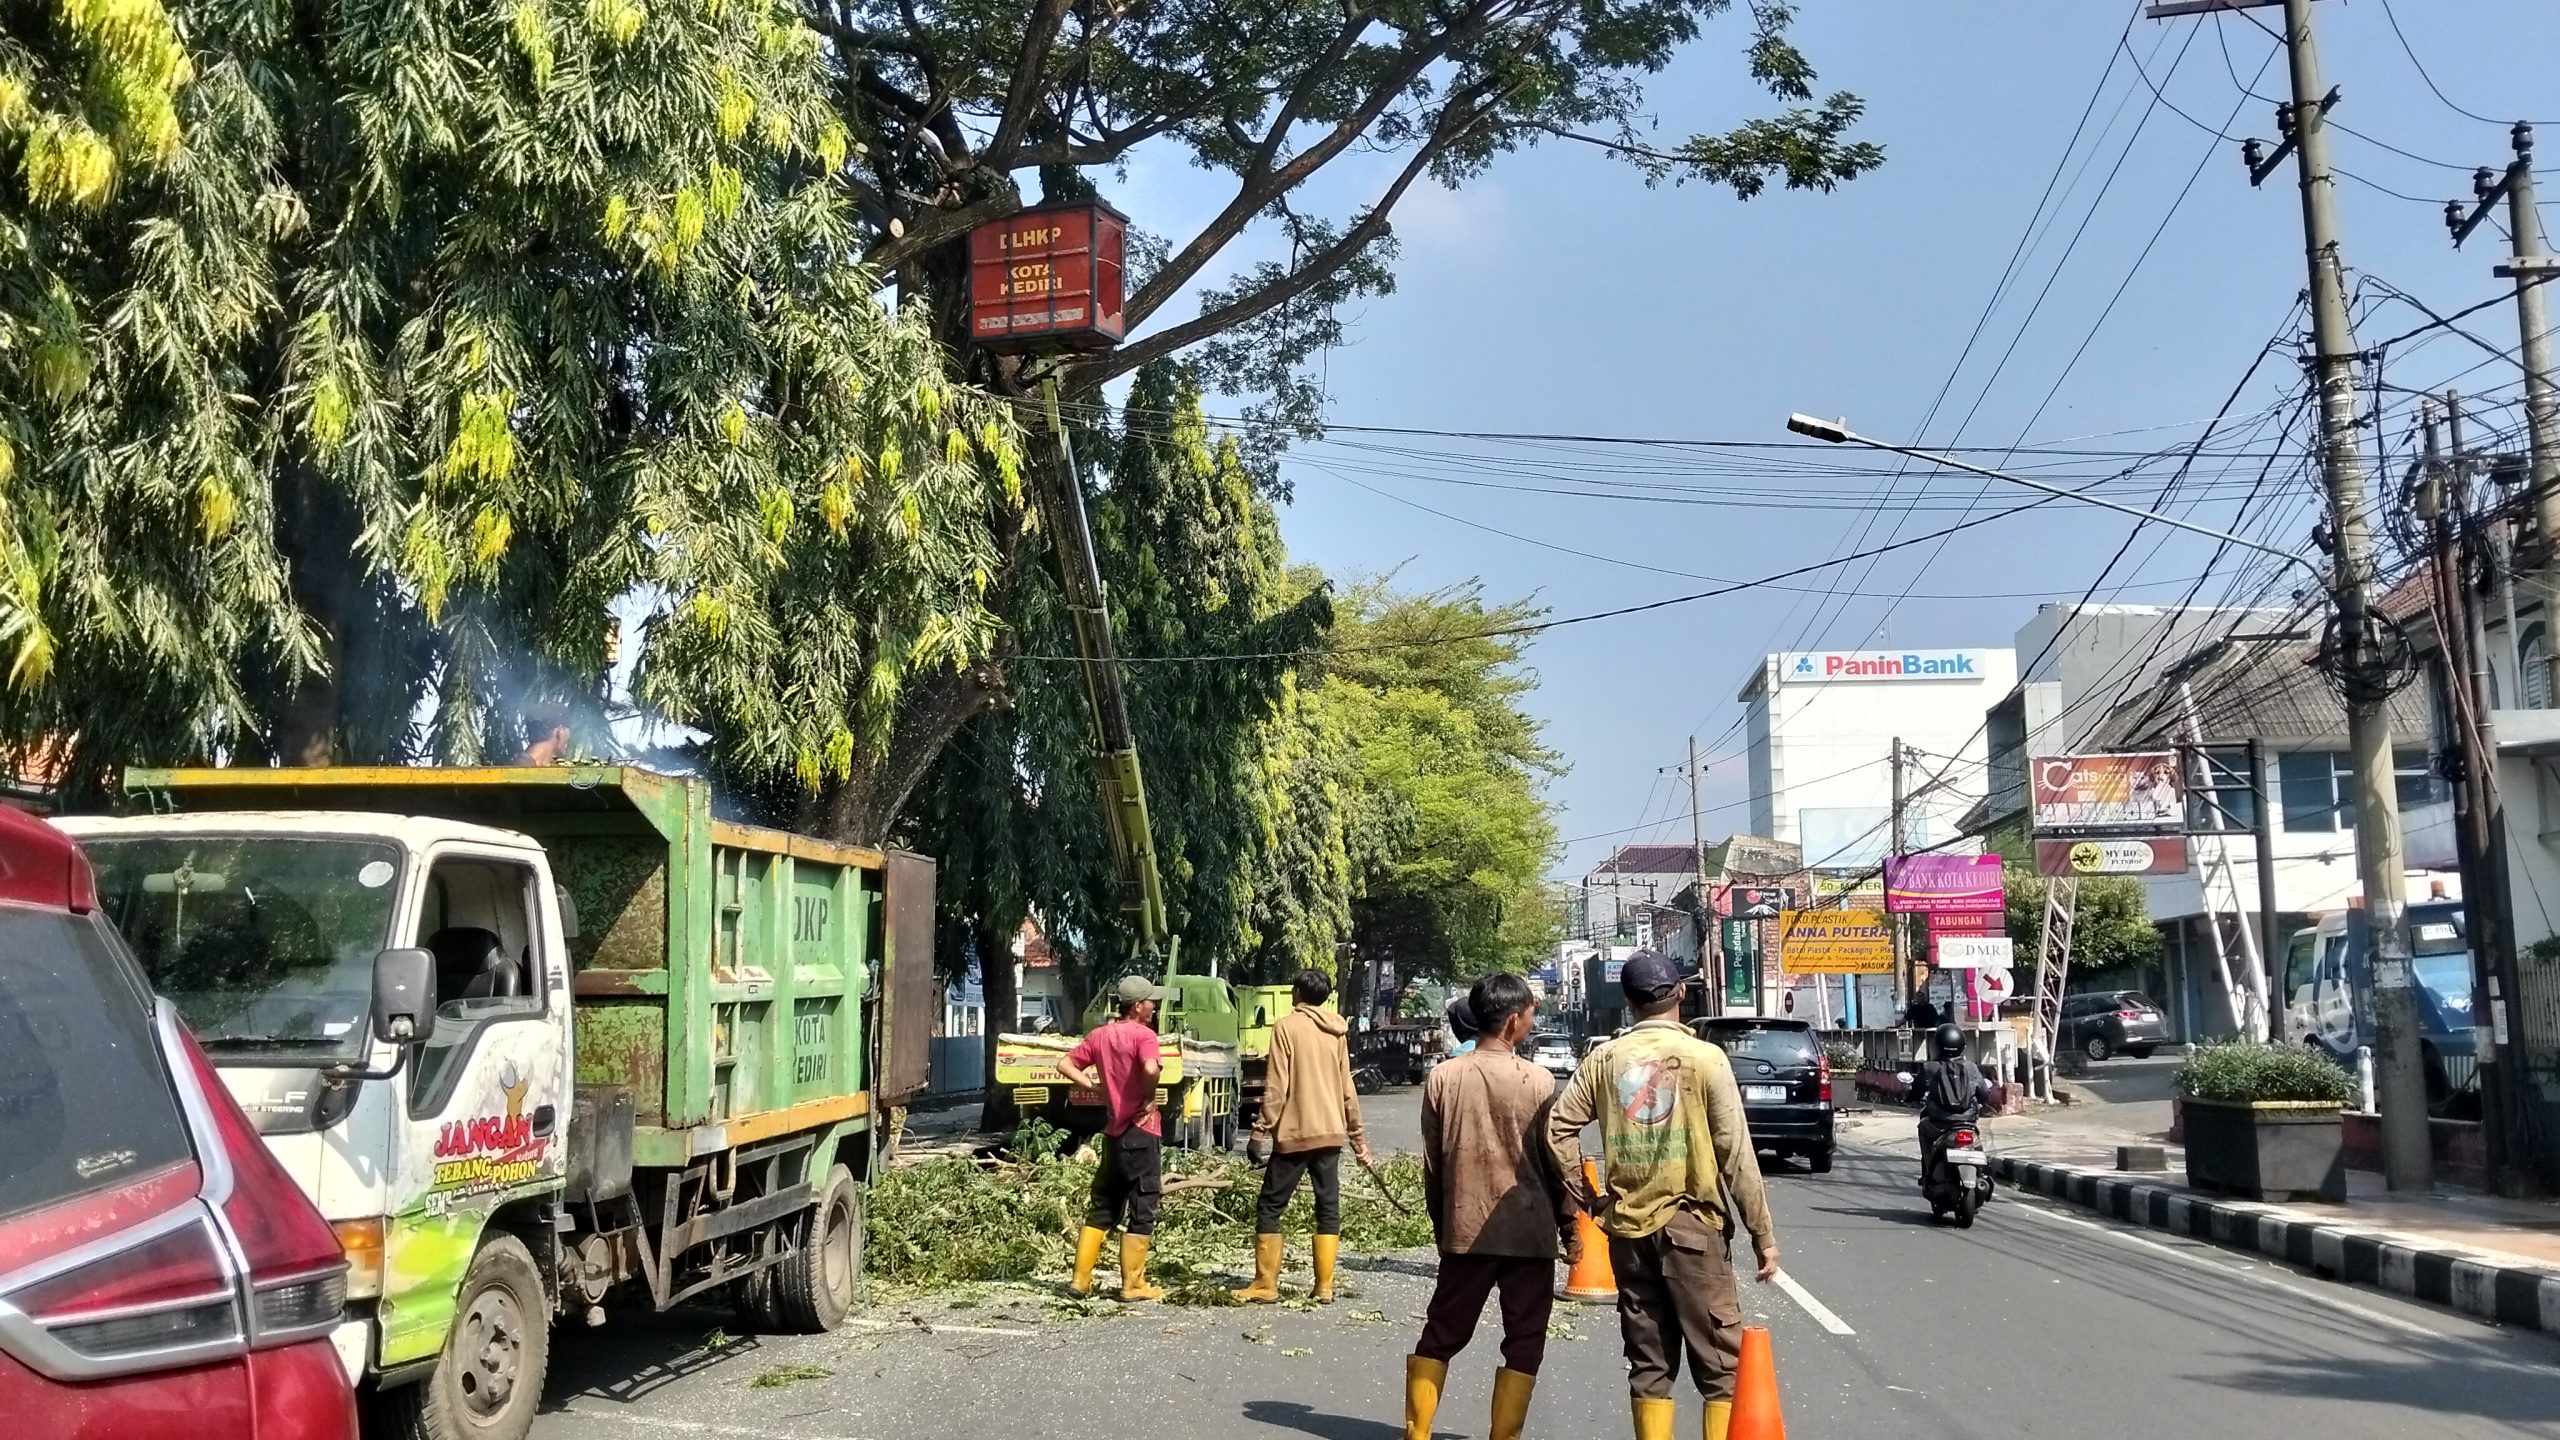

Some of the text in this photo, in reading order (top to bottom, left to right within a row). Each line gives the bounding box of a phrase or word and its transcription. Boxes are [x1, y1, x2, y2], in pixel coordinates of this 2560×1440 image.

[1826, 654, 1974, 675] PaninBank
[1821, 882, 1834, 891] 50
[1909, 871, 2000, 889] BANK KOTA KEDIRI
[1785, 914, 1849, 924] TOKO PLASTIK
[1934, 916, 1983, 926] TABUNGAN
[1785, 926, 1889, 938] ANNA PUTERA
[1839, 946, 1873, 955] Packaging
[1965, 944, 2000, 956] DMR
[1860, 962, 1885, 970] MASUK
[1571, 962, 1581, 1010] APOTIK
[794, 1015, 826, 1046] KOTA
[262, 1090, 308, 1104] LF
[434, 1113, 534, 1157] JANGAN
[434, 1156, 493, 1185] TEBANG
[492, 1159, 537, 1184] POHON
